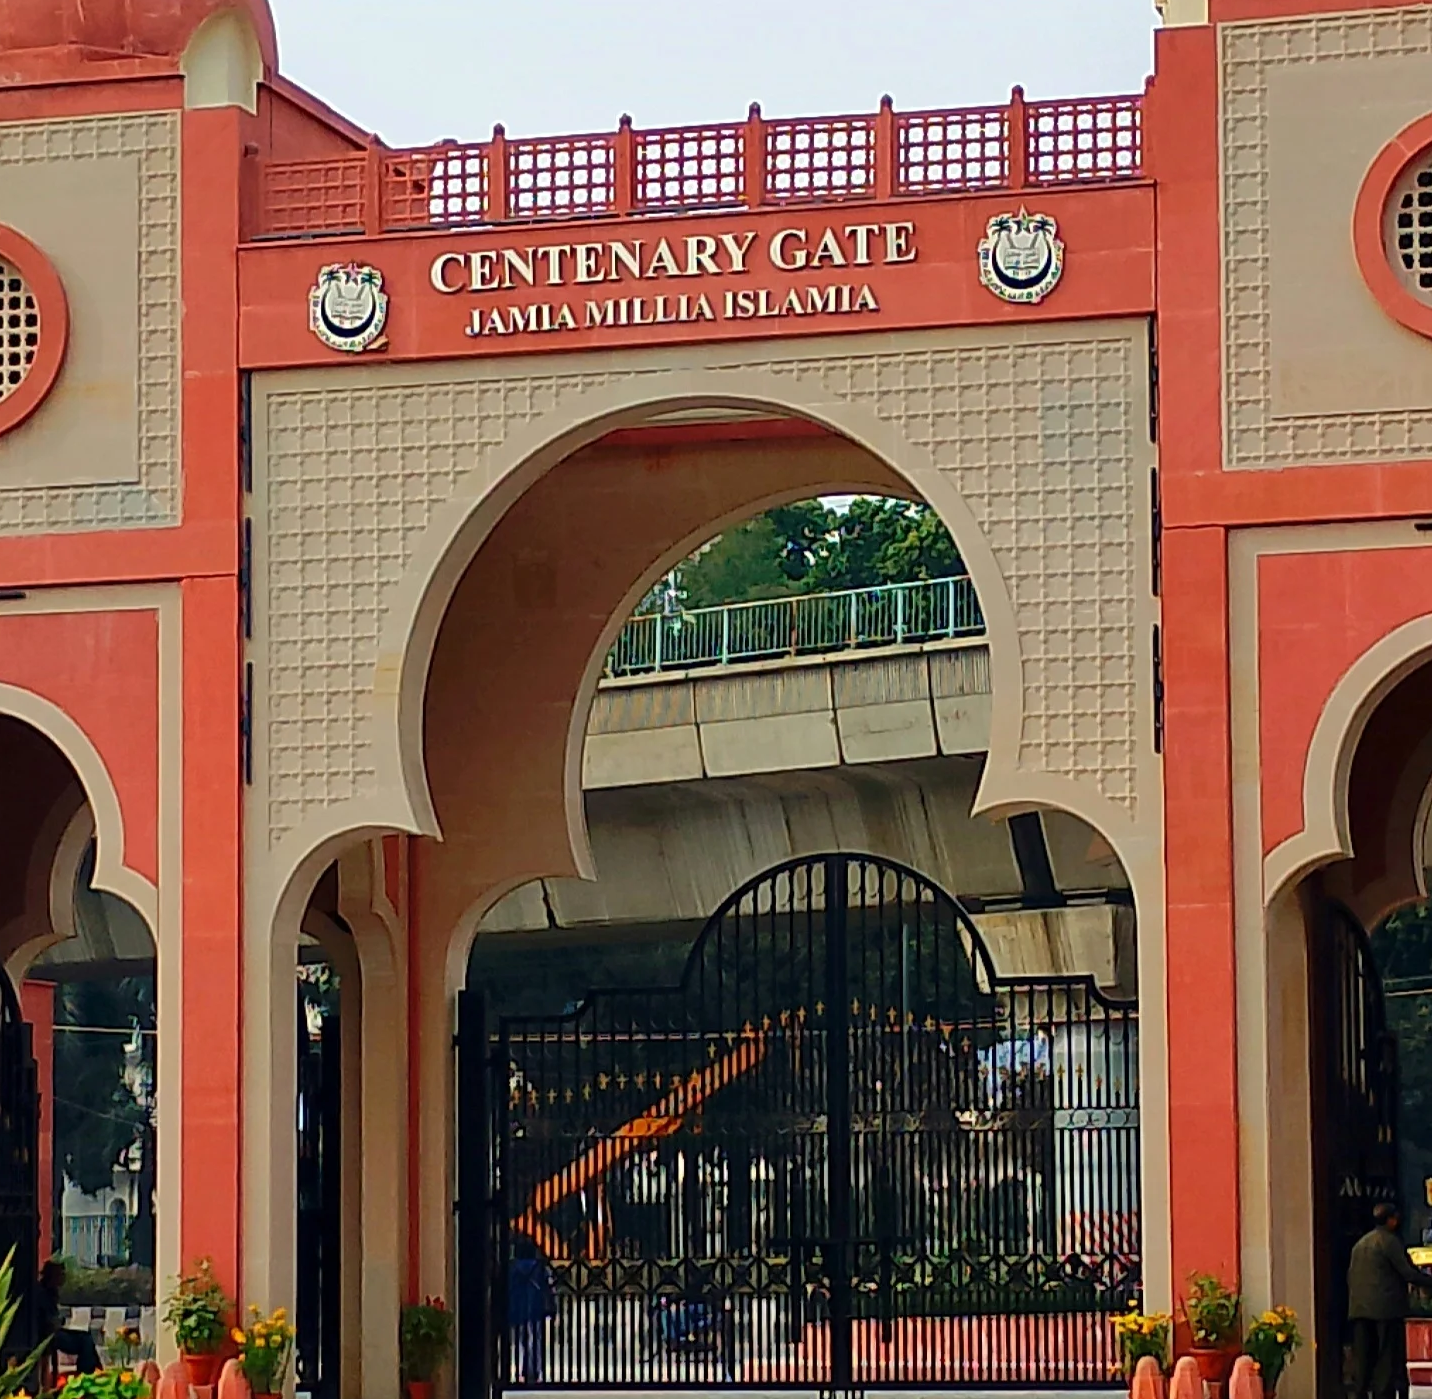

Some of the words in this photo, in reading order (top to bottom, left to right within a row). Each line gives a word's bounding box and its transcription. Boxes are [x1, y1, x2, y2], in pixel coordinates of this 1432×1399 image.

[430, 231, 758, 294] CENTENARY
[769, 220, 918, 270] GATE
[464, 302, 577, 337] JAMIA
[584, 292, 715, 326] MILLIA
[723, 283, 879, 319] ISLAMIA
